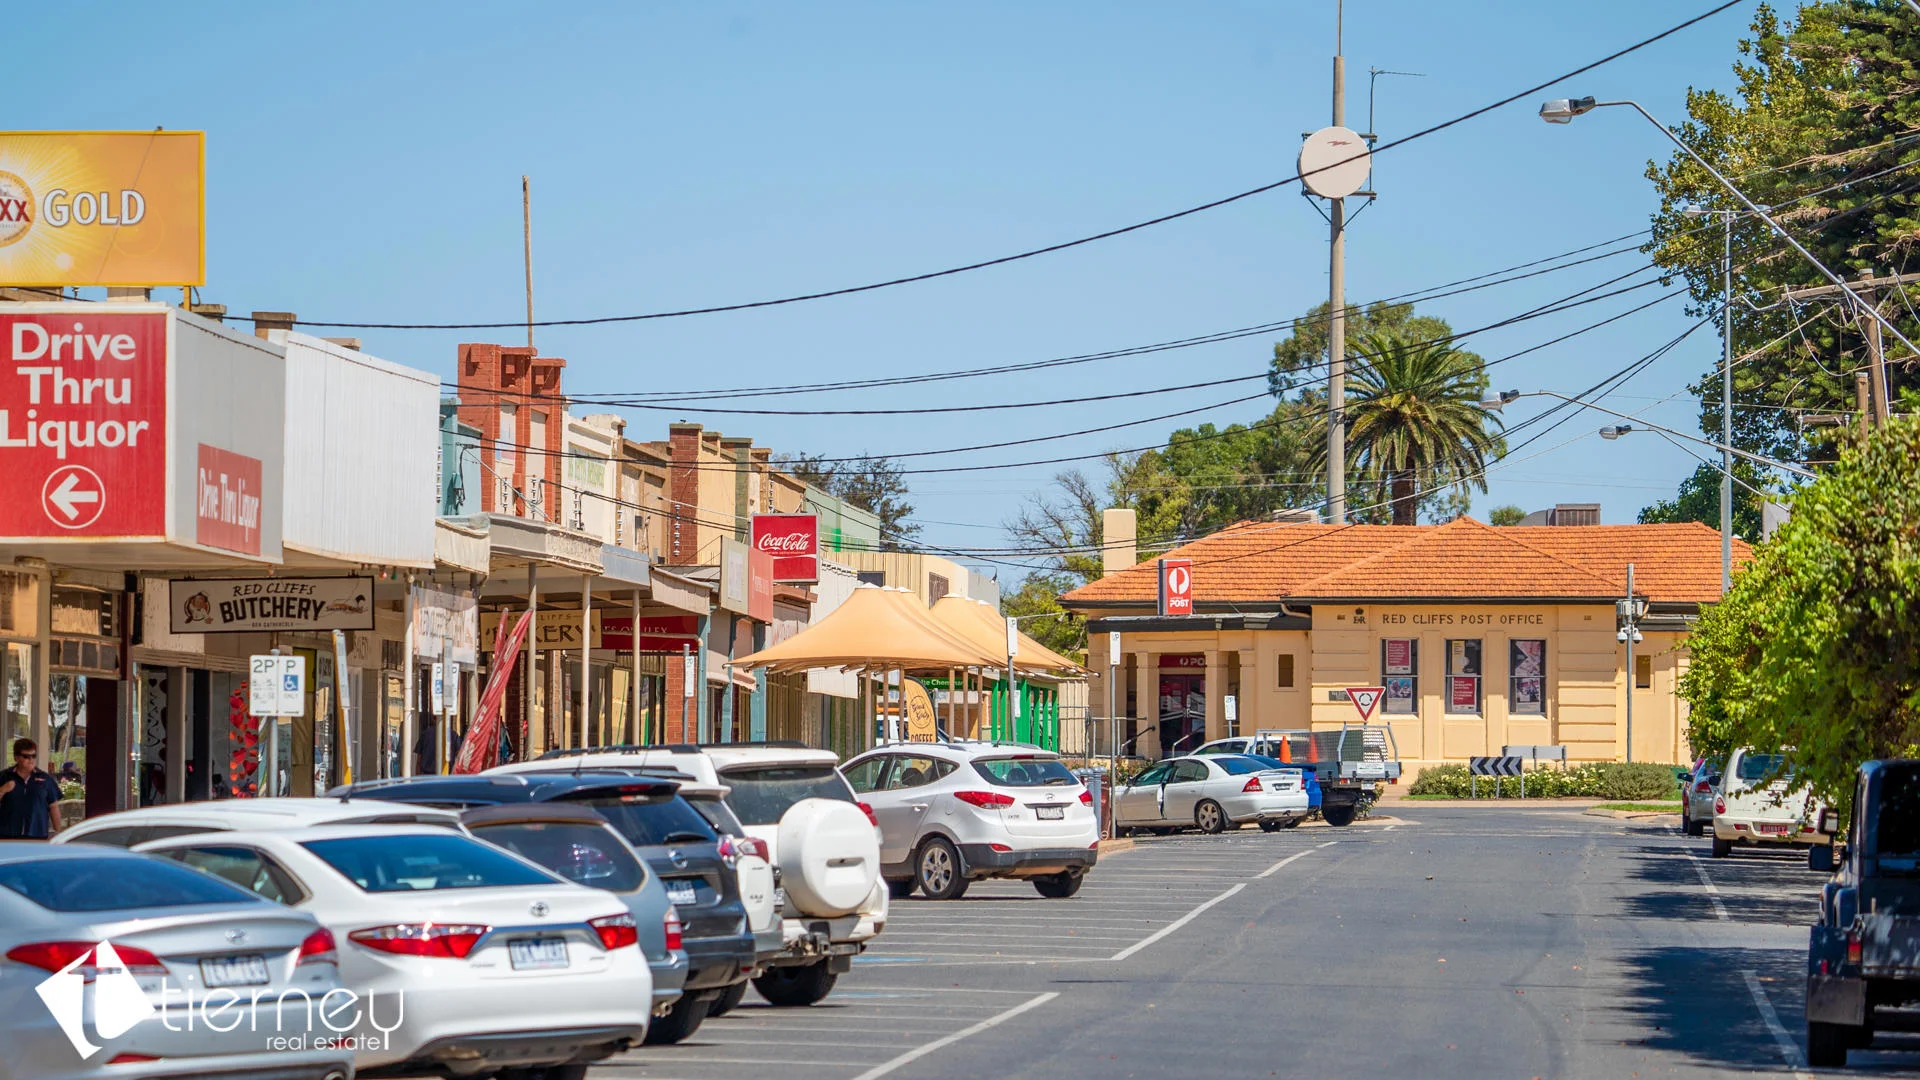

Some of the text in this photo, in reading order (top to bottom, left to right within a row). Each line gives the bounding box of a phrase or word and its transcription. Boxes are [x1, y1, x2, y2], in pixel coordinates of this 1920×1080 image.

[43, 188, 146, 228] GOLD
[12, 322, 136, 361] Drive
[17, 366, 131, 404] Thru
[0, 409, 149, 460] Liquor
[200, 467, 259, 543] Drive Thru Liquor
[758, 532, 812, 551] Coca-Cola
[232, 582, 316, 597] RED CLIFFS
[219, 596, 326, 624] BUTCHERY
[1169, 599, 1189, 608] POST
[1382, 614, 1544, 624] RED CLIFFS POST OFFICE
[253, 659, 275, 673] 2P
[286, 660, 296, 673] P
[1190, 658, 1205, 666] PO
